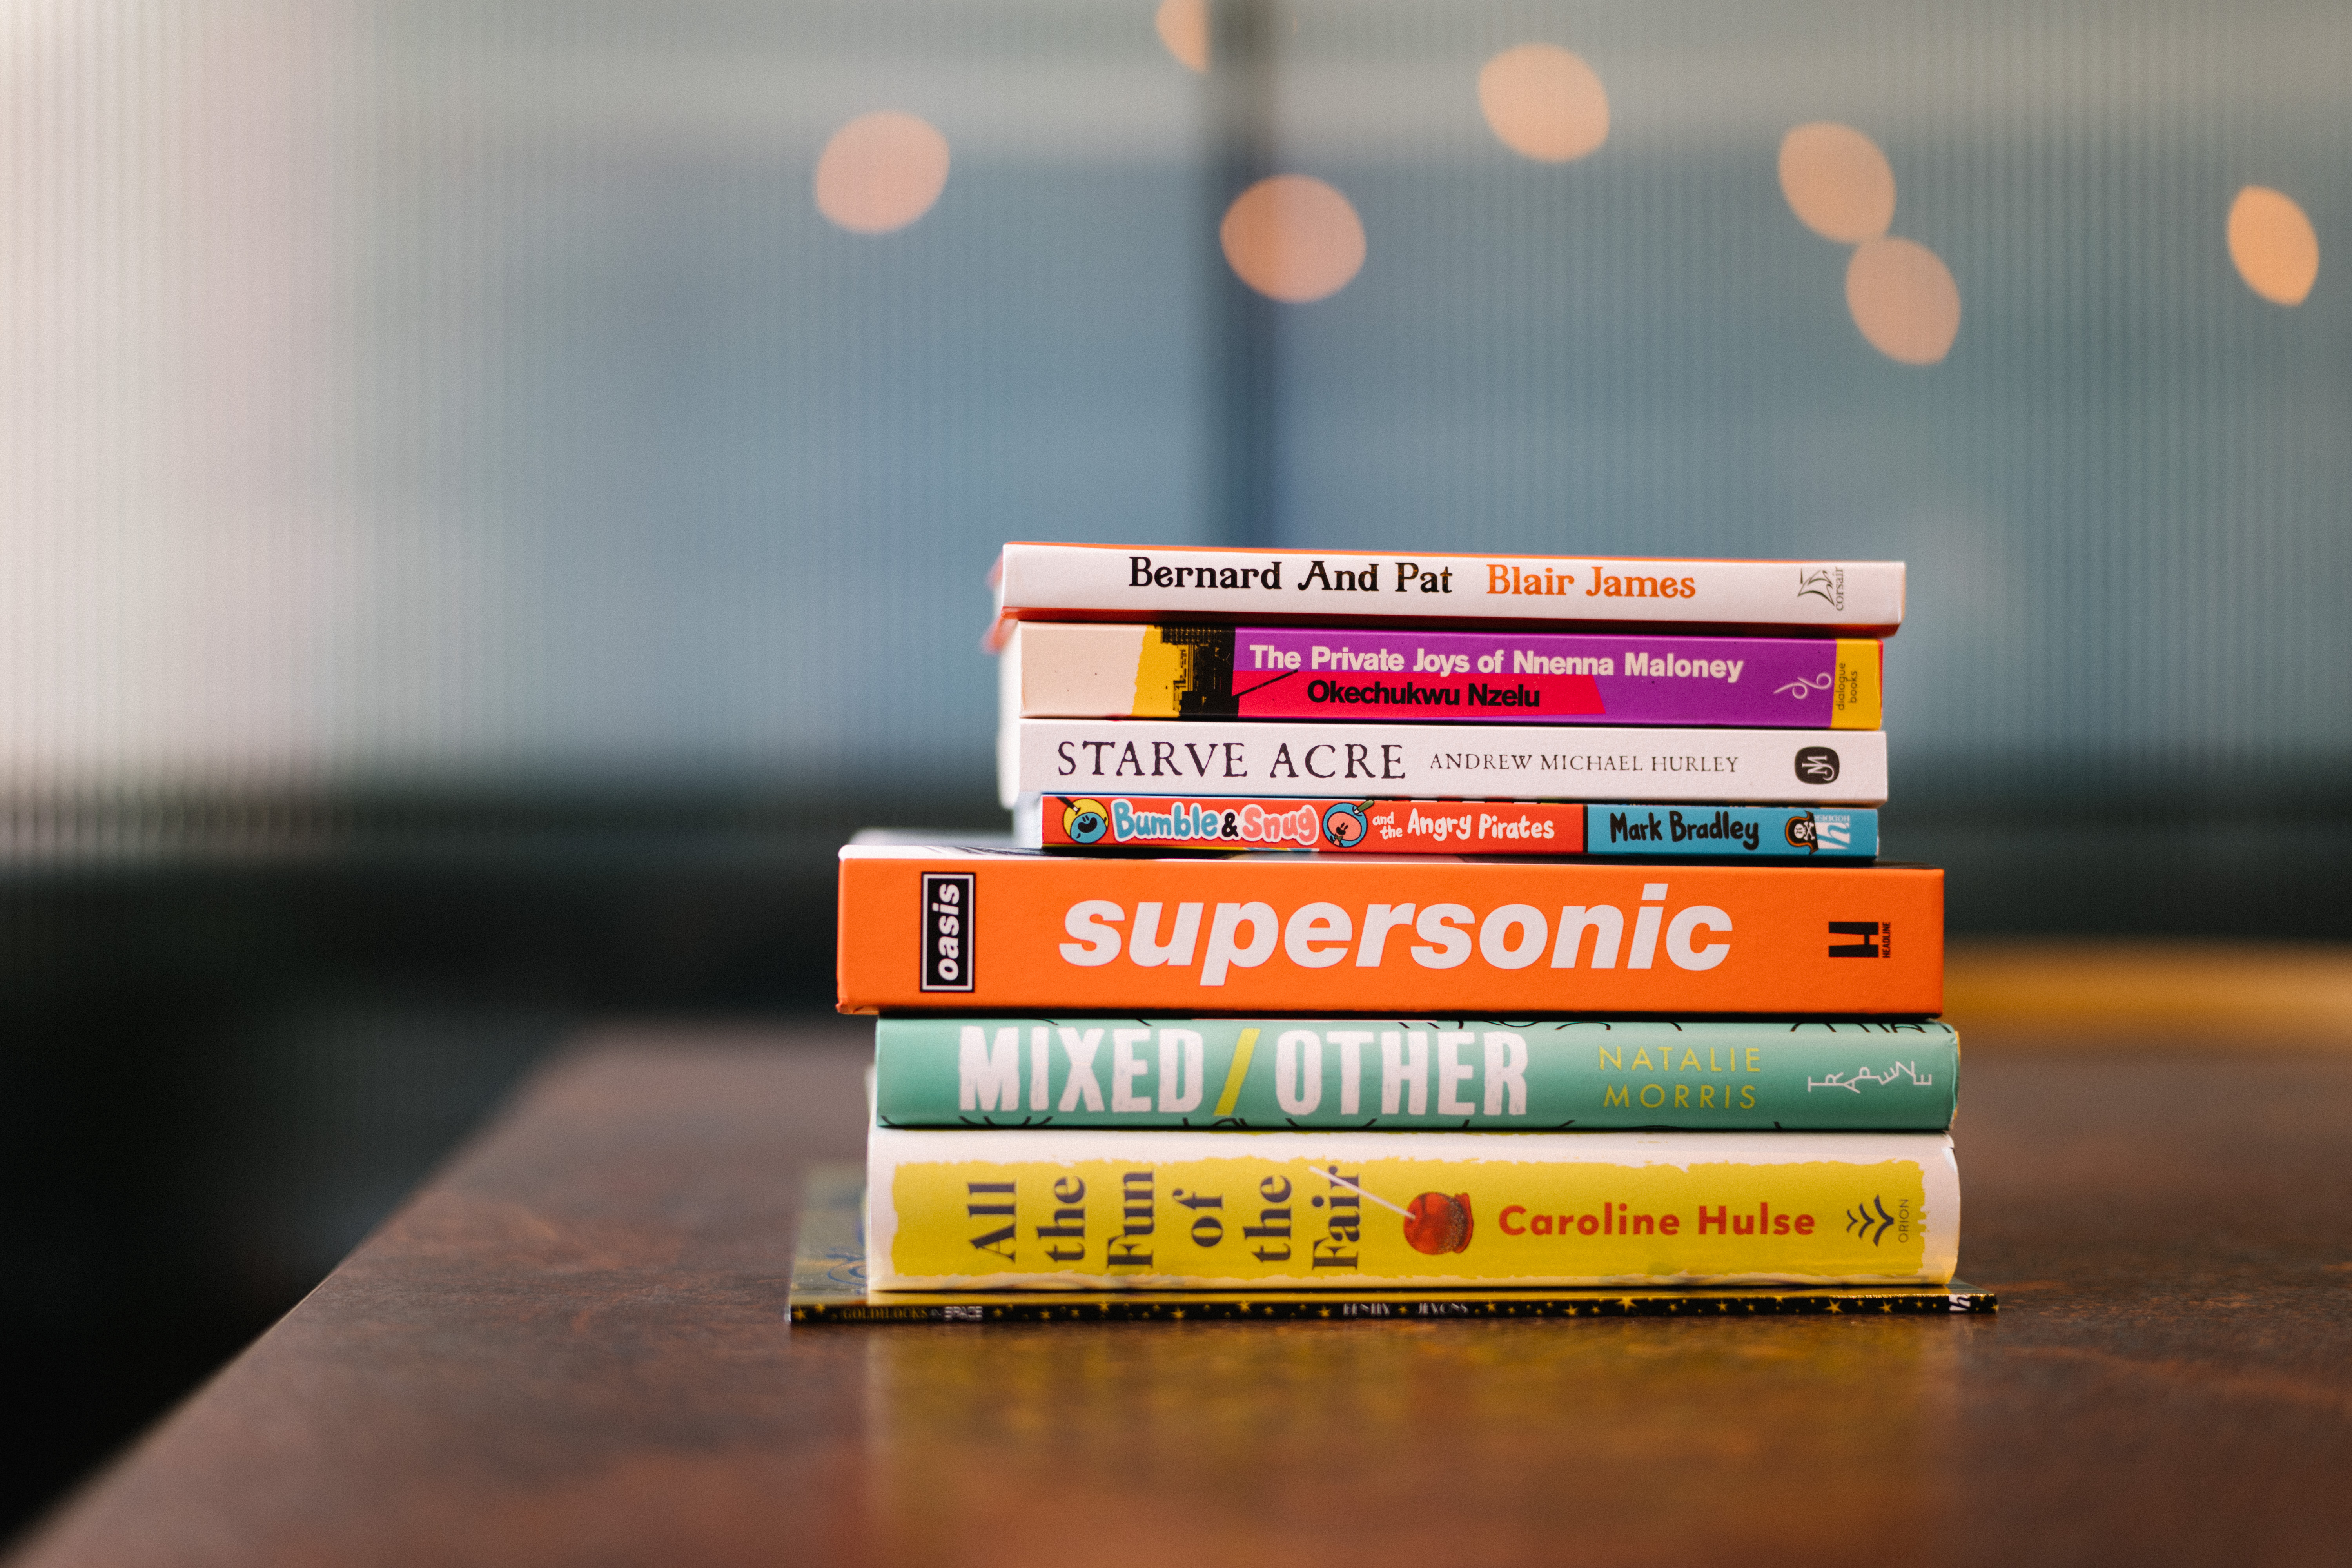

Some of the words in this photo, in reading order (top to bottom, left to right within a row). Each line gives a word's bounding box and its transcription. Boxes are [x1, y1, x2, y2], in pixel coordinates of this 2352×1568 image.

[1129, 557, 1282, 590] Bernard
[1297, 560, 1379, 591] And
[1395, 562, 1453, 593] Pat
[1486, 564, 1574, 596] Blair
[1586, 566, 1696, 599] James
[1833, 567, 1844, 611] corsair
[1250, 645, 1301, 670] The
[1312, 647, 1404, 672] Private
[1413, 648, 1470, 677] Joys
[1477, 650, 1504, 674] of
[1514, 650, 1613, 676] Nnenna
[1624, 653, 1743, 683] Maloney
[1308, 680, 1460, 705] Okechukwu
[1468, 683, 1540, 708] Nzelu
[1836, 663, 1847, 710] dialogue
[1848, 670, 1857, 703] books
[1058, 741, 1248, 776] STARVE
[1270, 742, 1406, 779] ACRE
[1430, 753, 1532, 771] ANDREW
[1541, 754, 1643, 773] MICHAEL
[1651, 756, 1738, 773] HURLEY
[1372, 811, 1394, 826] and
[1380, 826, 1403, 840] the
[1407, 808, 1471, 841] Angry
[1478, 813, 1555, 839] Pirates
[1610, 811, 1663, 843] Mark
[1670, 810, 1759, 850] Bradley
[933, 884, 960, 981] oasis
[1059, 883, 1733, 986] supersonic
[1599, 1045, 1760, 1072] NATALIE
[1603, 1084, 1756, 1110] MORRIS
[967, 1180, 1016, 1264] All
[1036, 1175, 1086, 1263] the
[1107, 1170, 1155, 1269] Fun
[1172, 1188, 1223, 1247] of
[1243, 1174, 1292, 1263] the
[1312, 1166, 1359, 1270] Fair
[1498, 1202, 1680, 1236] Caroline
[1698, 1202, 1816, 1236] Hulse
[1898, 1199, 1909, 1243] ORION
